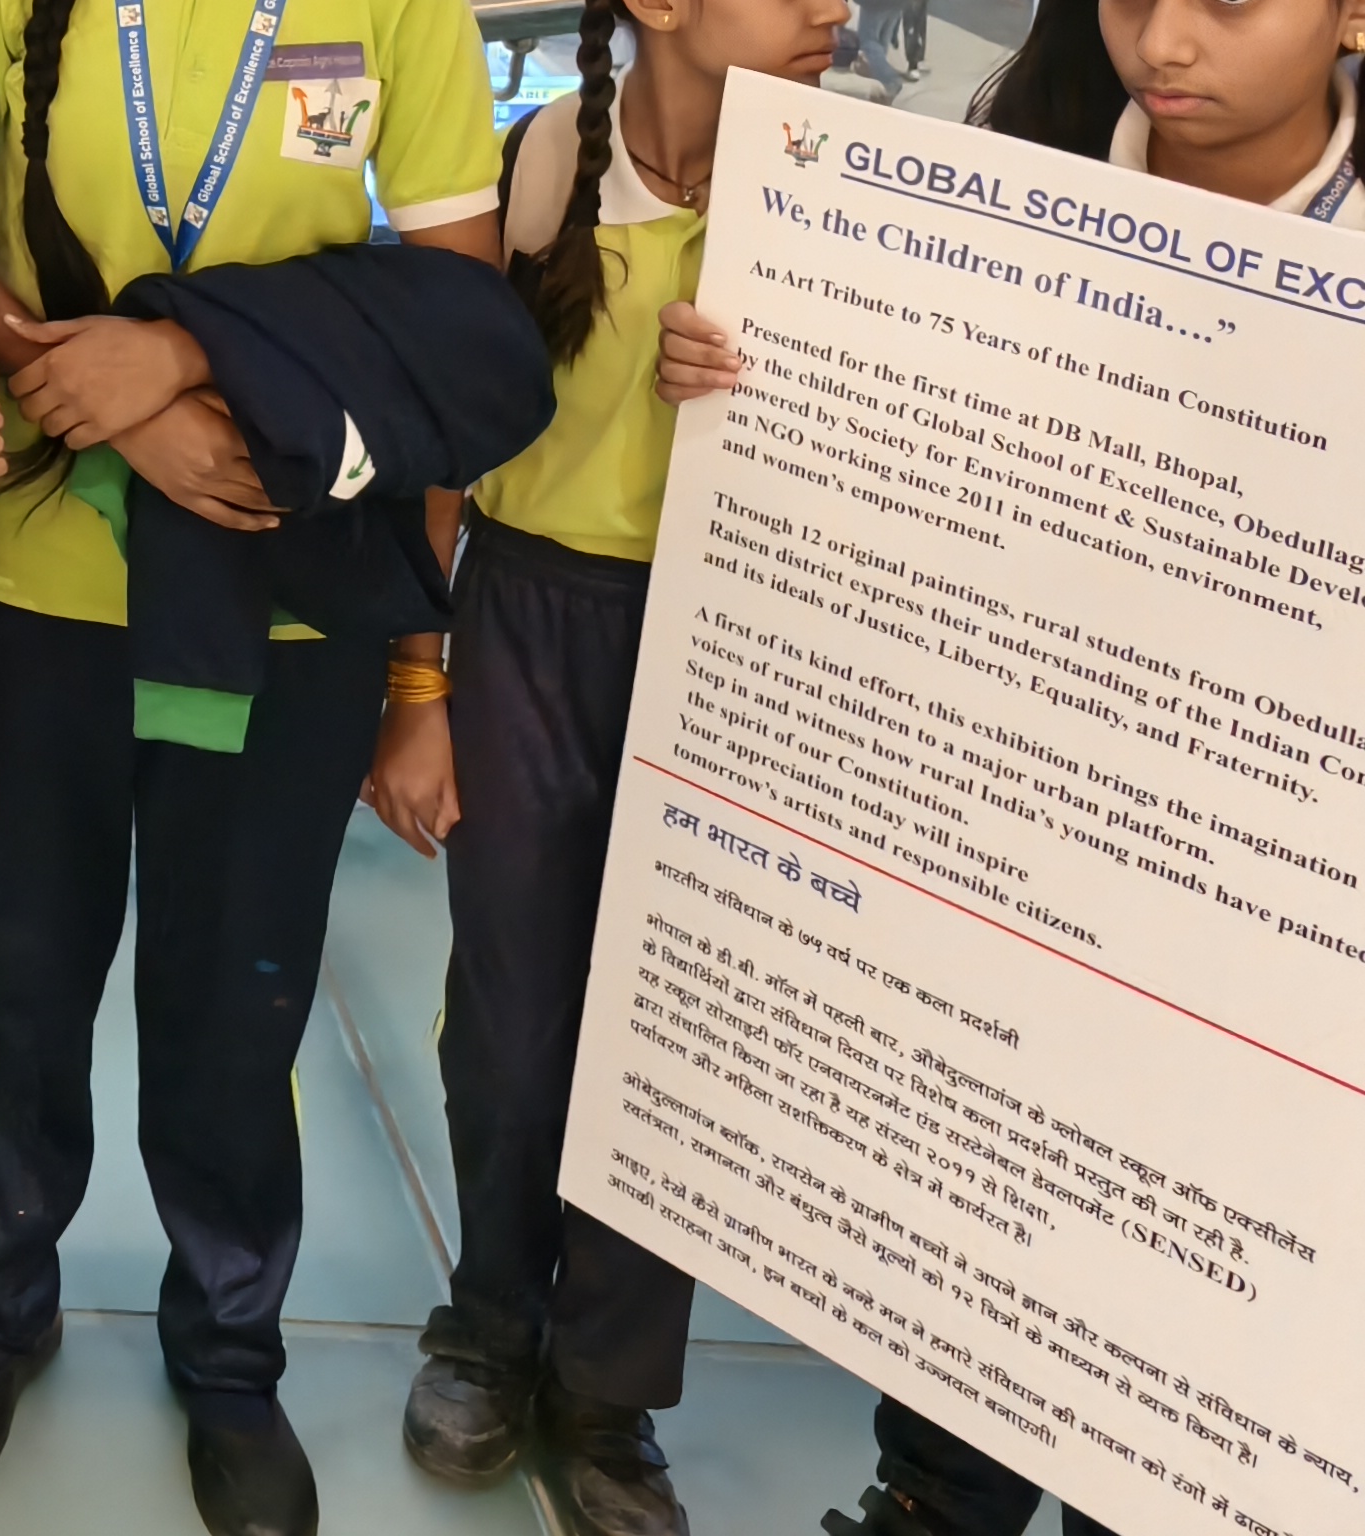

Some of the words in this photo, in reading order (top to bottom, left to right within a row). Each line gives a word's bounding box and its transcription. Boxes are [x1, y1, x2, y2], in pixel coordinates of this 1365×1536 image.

[128, 29, 145, 98] Excellence
[234, 37, 265, 105] Excellence
[135, 99, 147, 114] of
[137, 115, 153, 160] School
[231, 103, 242, 121] of
[212, 120, 239, 165] School
[145, 162, 160, 203] Global
[197, 164, 221, 204] Global
[844, 141, 1011, 211] GLOBAL
[1023, 188, 1191, 263] SCHOOL
[1204, 240, 1263, 279] OF
[1314, 174, 1349, 219] School
[762, 185, 811, 229] We,
[821, 208, 867, 242] the
[876, 223, 1023, 286] Children
[1034, 271, 1072, 299] of
[749, 260, 776, 281] An
[780, 269, 814, 293] Art
[820, 278, 895, 317] Tribute
[901, 306, 921, 325] to
[929, 311, 955, 334] 75
[962, 320, 1021, 355] Years
[1027, 346, 1052, 364] of
[1055, 352, 1089, 376] the
[1096, 362, 1170, 403] Indian
[1177, 389, 1327, 451] Constitution
[741, 317, 833, 363] Presented
[838, 350, 869, 373] for
[873, 363, 906, 386] the
[912, 374, 957, 403] first
[963, 392, 1012, 421] time
[1017, 412, 1039, 430] at
[1045, 416, 1081, 443] DB
[1088, 430, 1146, 467] Mall,
[1154, 450, 1243, 499] Bhopal,
[679, 712, 723, 745] Your
[725, 739, 844, 801] appreciation
[850, 792, 903, 830] today
[913, 822, 950, 848] will
[955, 836, 1029, 883] inspire
[662, 801, 701, 837] हम
[706, 823, 771, 870] भारत
[776, 851, 803, 883] के
[809, 871, 862, 914] बच्चे
[782, 795, 843, 831] artists
[848, 825, 886, 850] and
[892, 844, 1009, 906] responsible
[1015, 900, 1102, 950] citizens.
[654, 859, 710, 897] भारतीय
[713, 887, 774, 929] संविधान
[777, 917, 794, 937] के
[797, 928, 823, 954] ७५
[826, 943, 851, 967] वर्ष
[855, 958, 878, 980] पर
[882, 971, 911, 995] एक
[915, 987, 954, 1018] कला
[959, 1008, 1020, 1050] प्रदर्शनी
